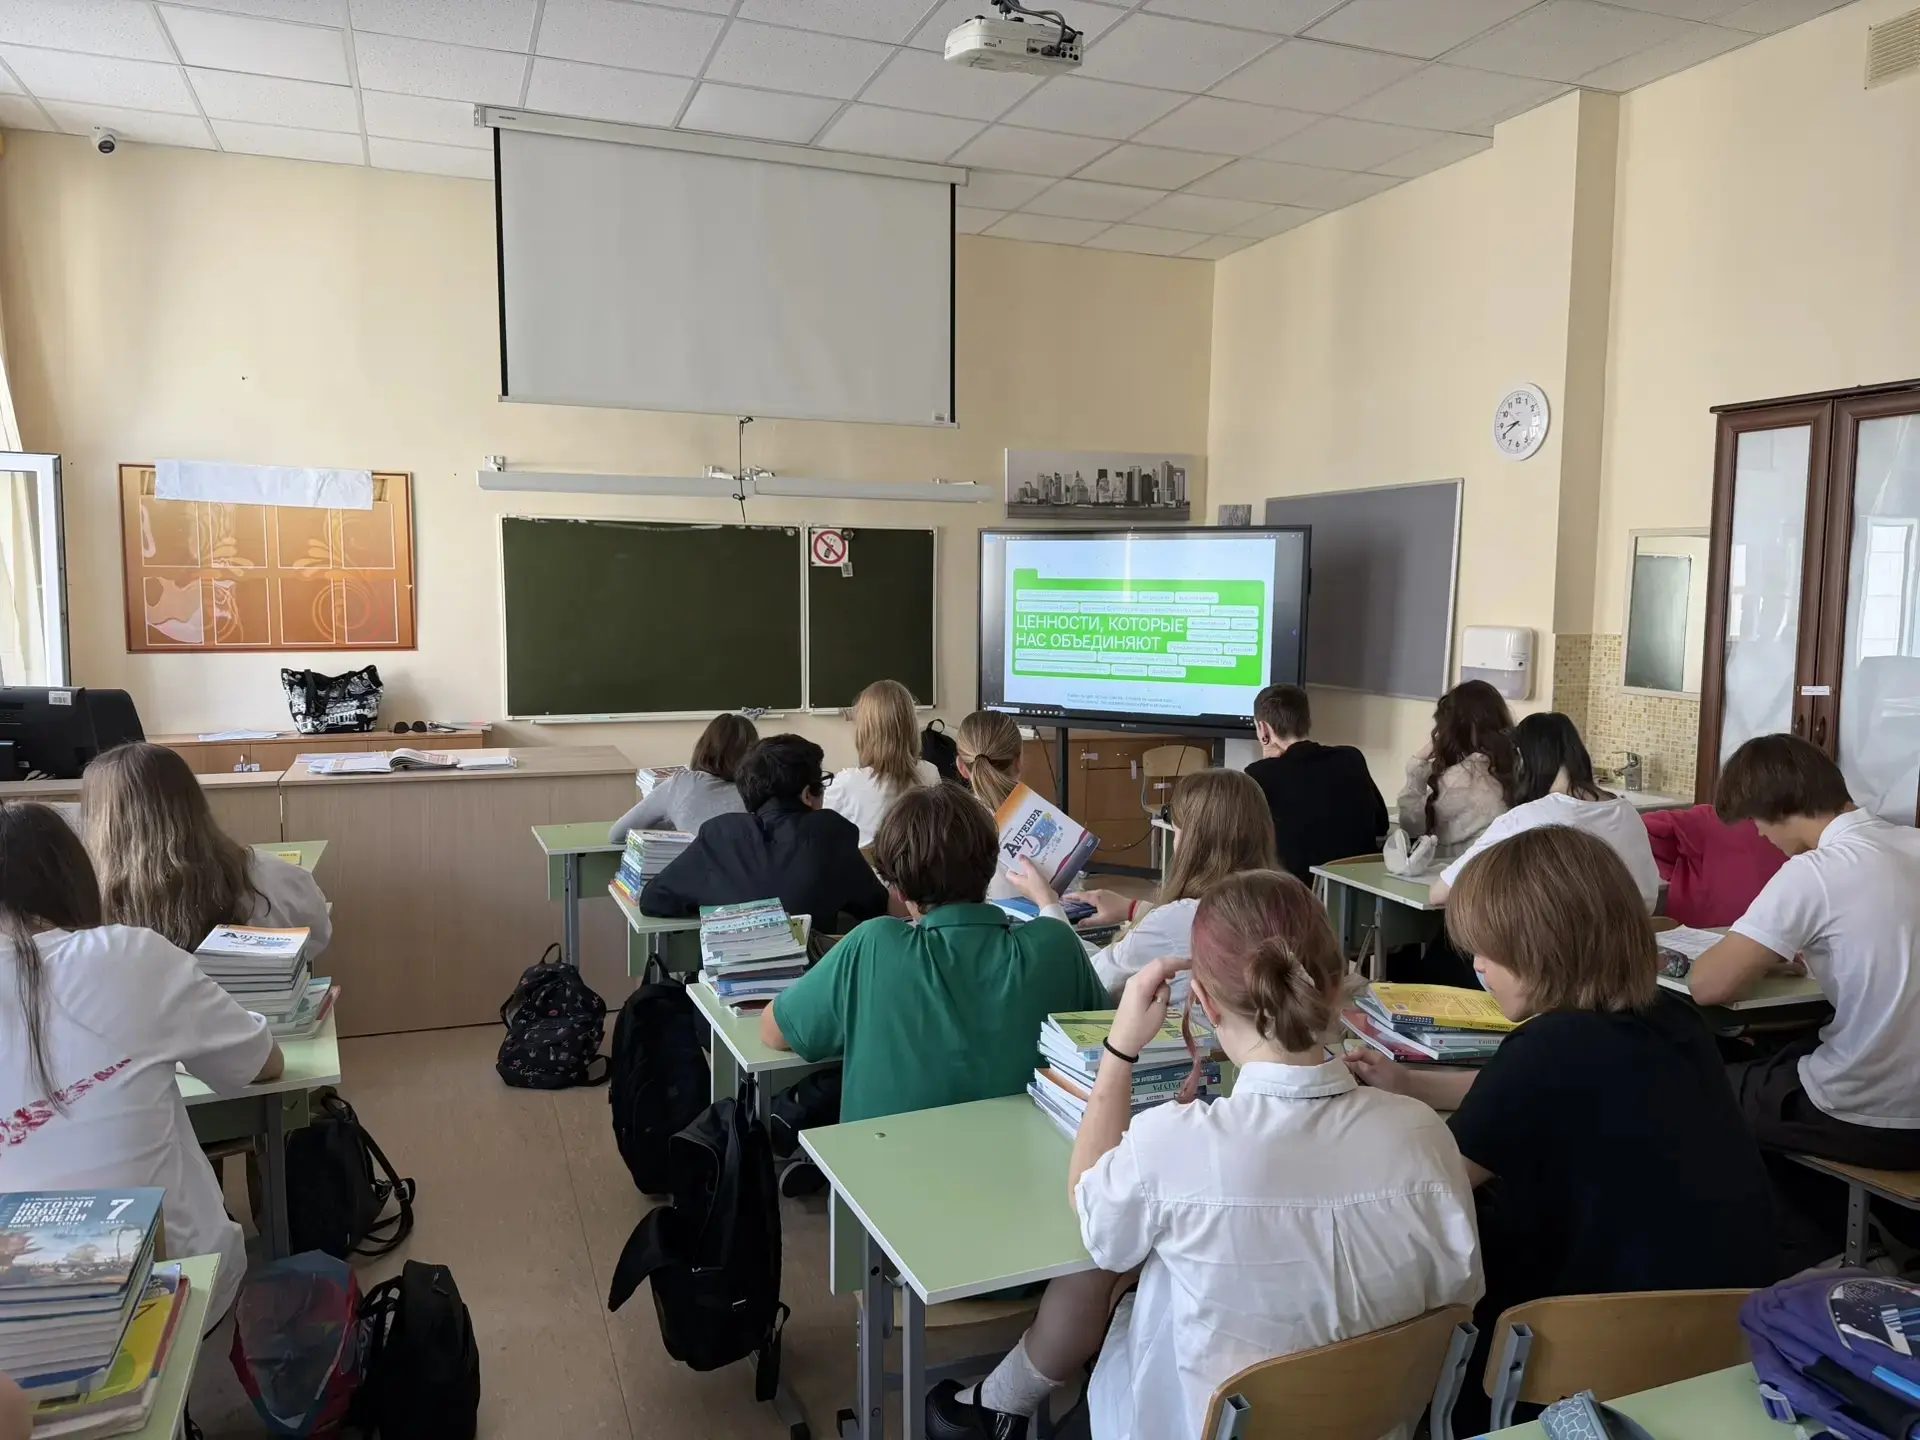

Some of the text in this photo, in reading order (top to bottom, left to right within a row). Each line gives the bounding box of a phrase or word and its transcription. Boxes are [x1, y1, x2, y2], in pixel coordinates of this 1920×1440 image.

[1503, 410, 1508, 418] 10
[1016, 614, 1185, 633] ЦЕННОСТИ, КОТОРЫЕ
[1016, 632, 1047, 647] НАС
[1050, 633, 1161, 651] ОБЪЕДИНЯЮТ
[1021, 838, 1034, 849] 7
[20, 1200, 94, 1209] ИСТОРИЯ
[106, 1198, 135, 1220] 7
[15, 1208, 79, 1216] НОВОГО
[10, 1213, 87, 1224] ВРЕМЕНИ
